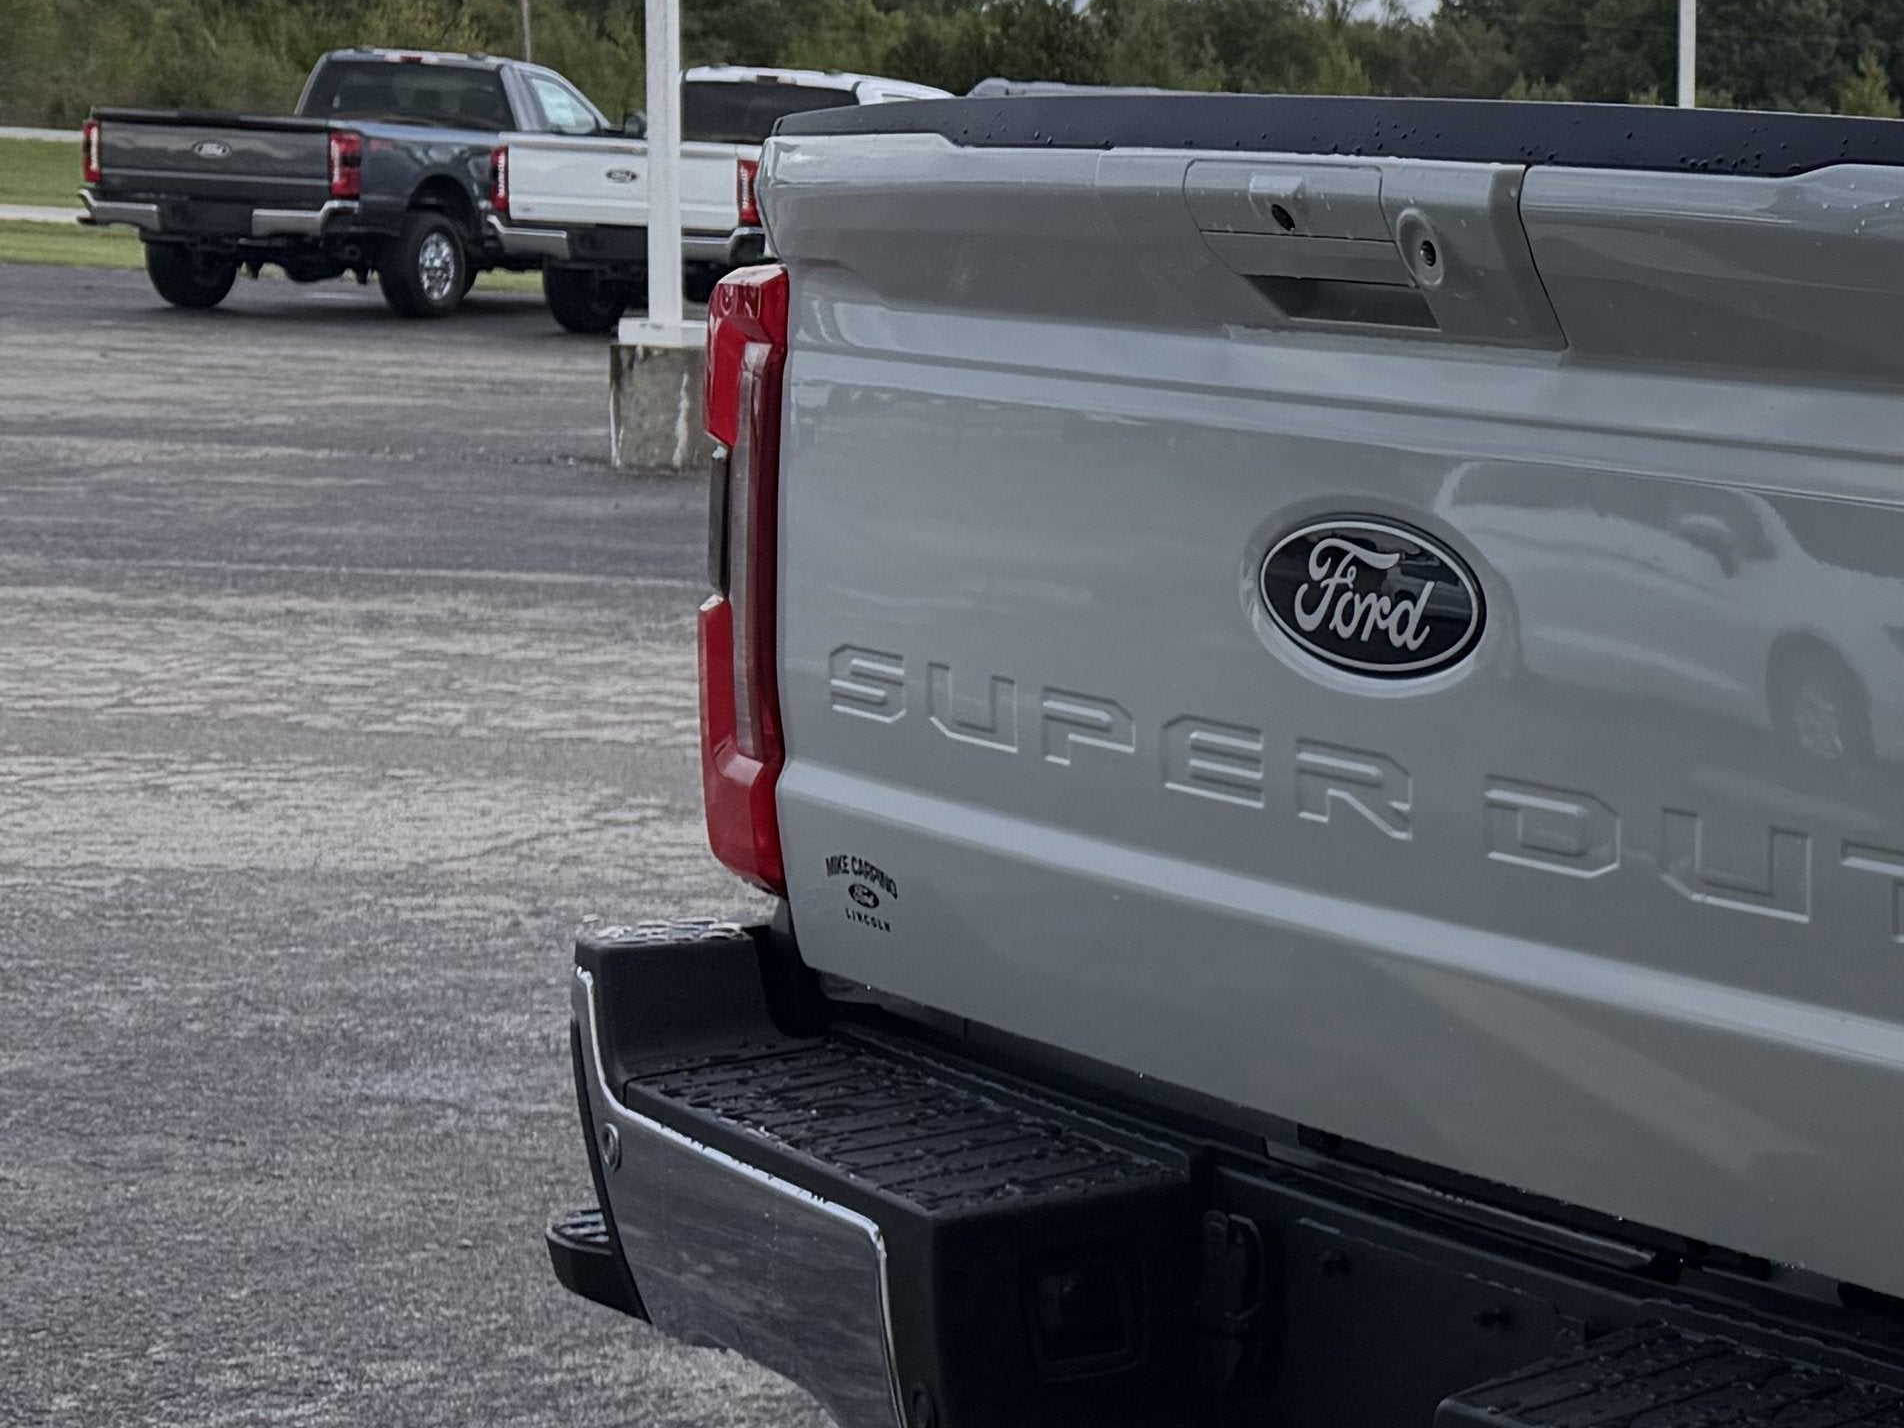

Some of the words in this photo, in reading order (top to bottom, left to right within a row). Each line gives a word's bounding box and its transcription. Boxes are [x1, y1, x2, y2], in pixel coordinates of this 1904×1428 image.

[1294, 538, 1435, 652] Ford
[828, 643, 1413, 840] SUPER
[825, 855, 850, 877] MIKE
[845, 907, 891, 933] LINCOLN
